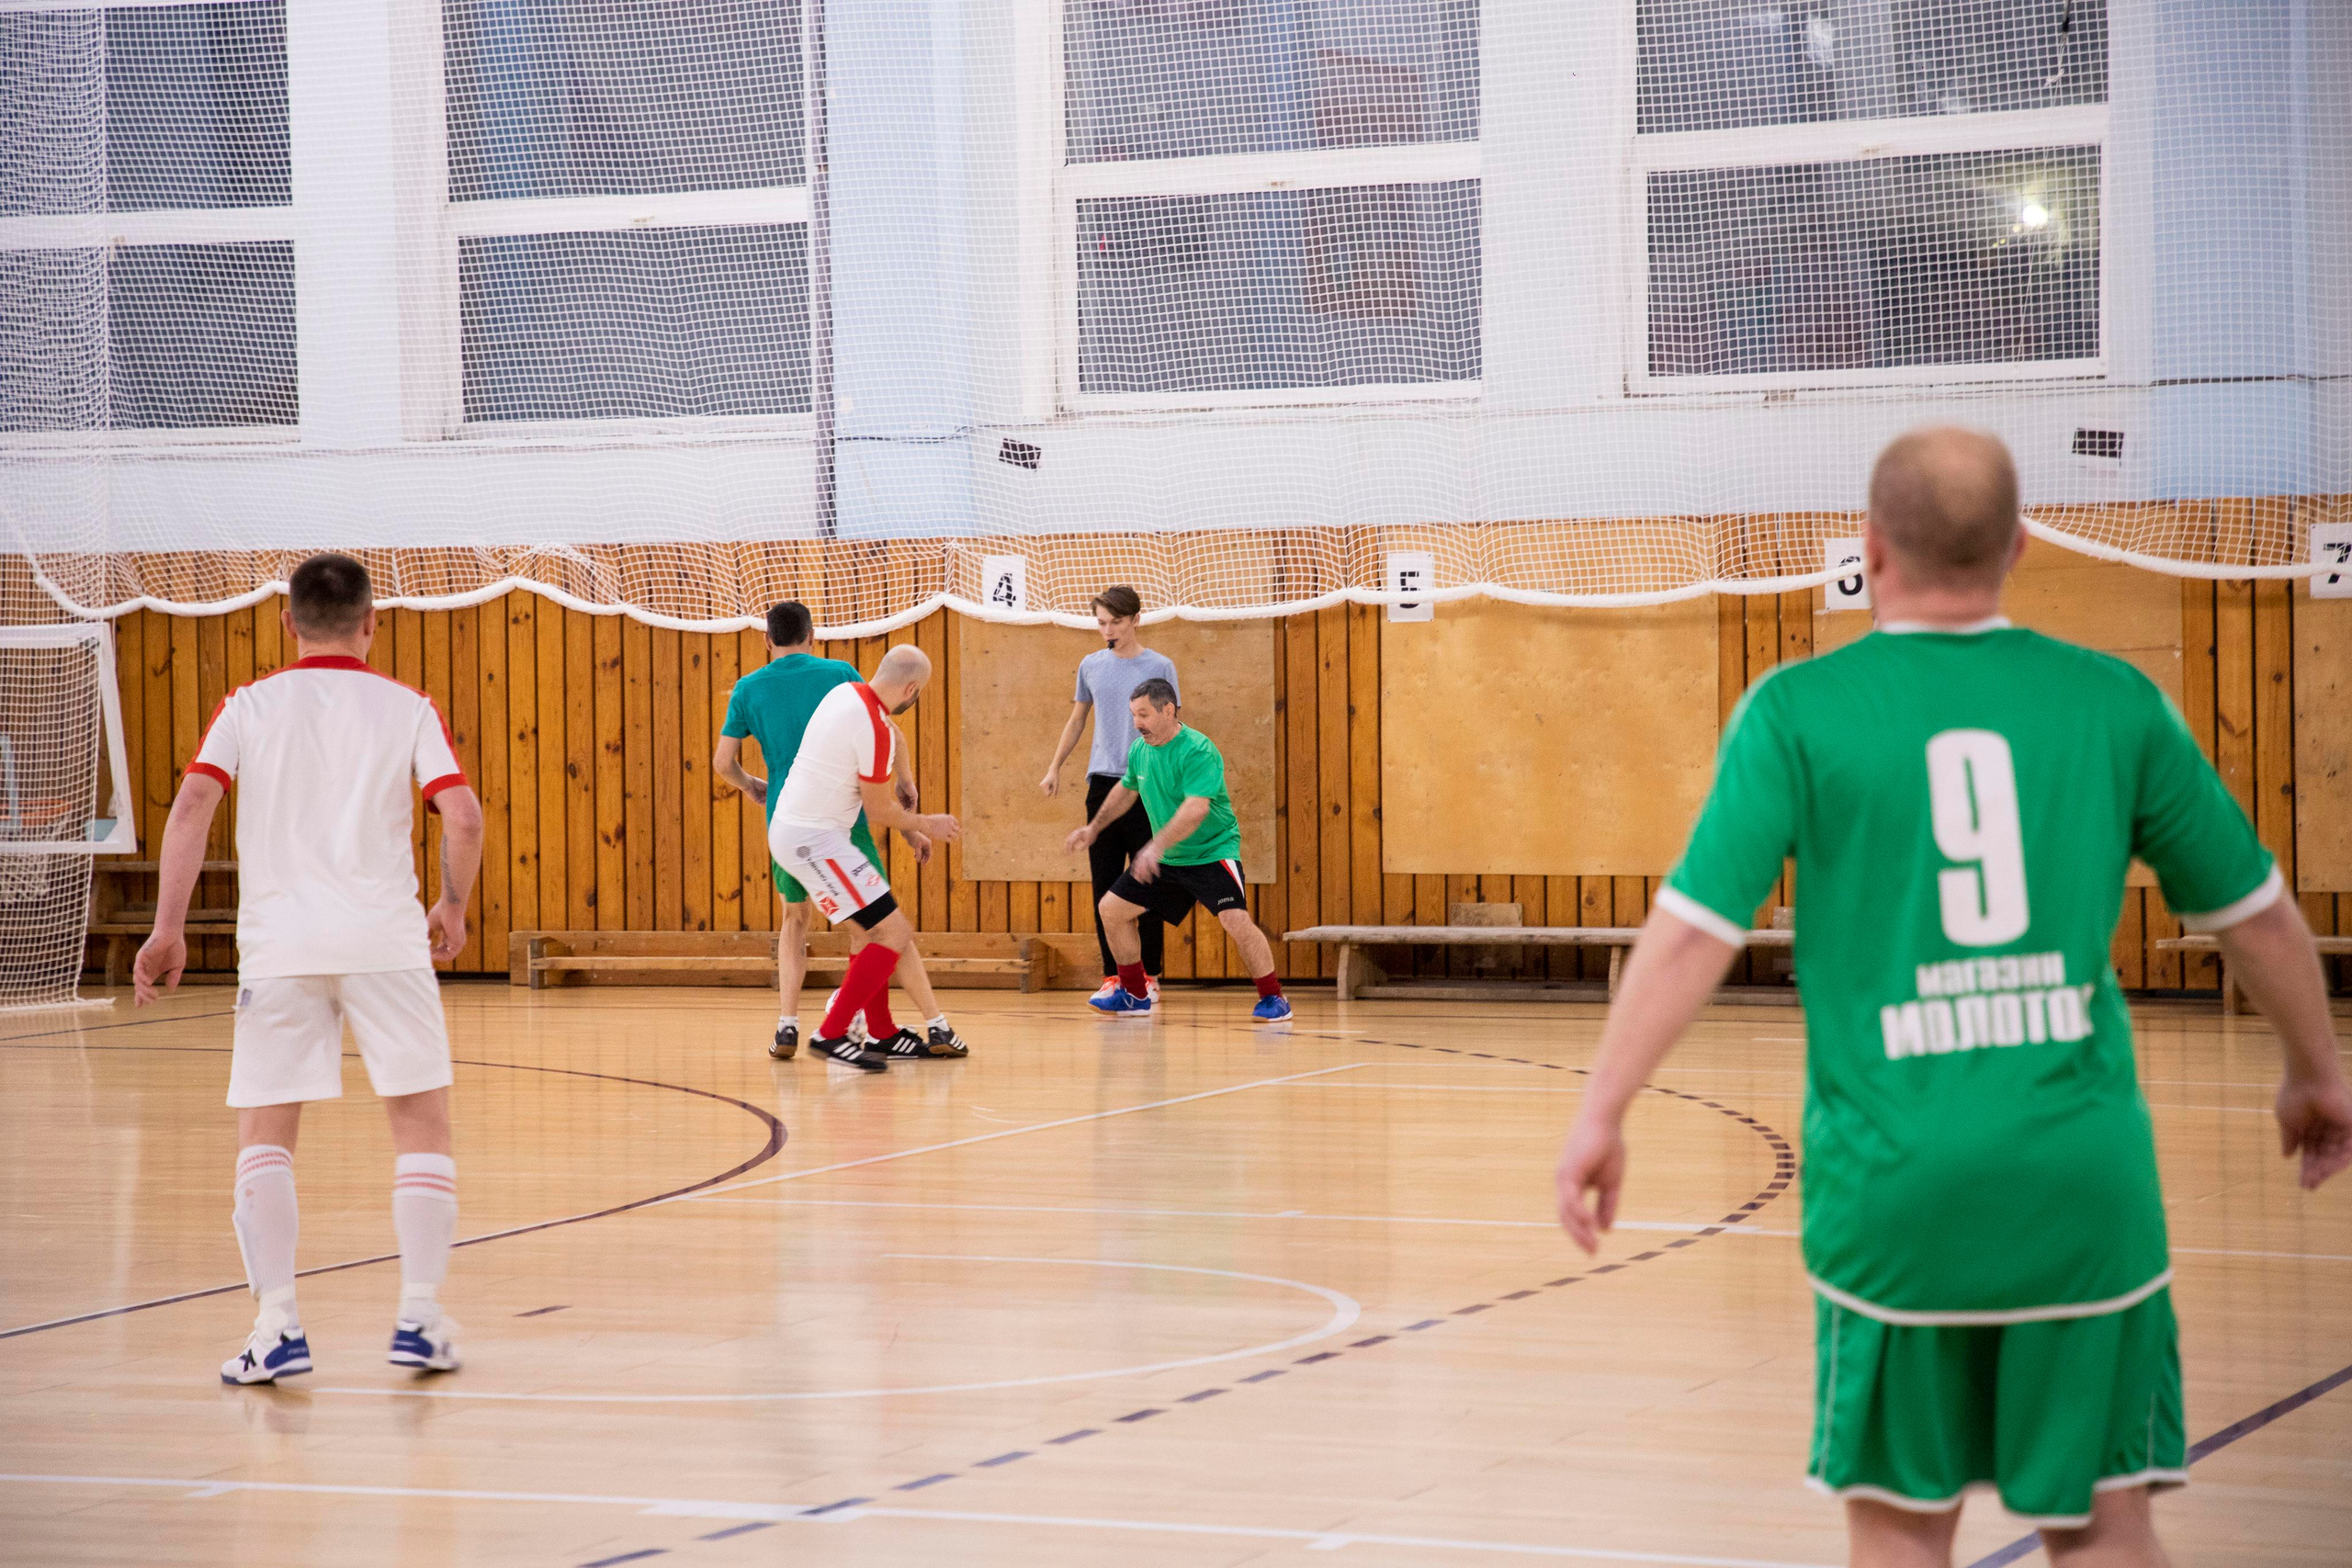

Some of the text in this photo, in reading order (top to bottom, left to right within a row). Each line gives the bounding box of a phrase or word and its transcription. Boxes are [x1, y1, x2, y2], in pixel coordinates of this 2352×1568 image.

[2323, 542, 2352, 584] 7
[992, 572, 1016, 608] 4
[1926, 728, 2030, 946] 9
